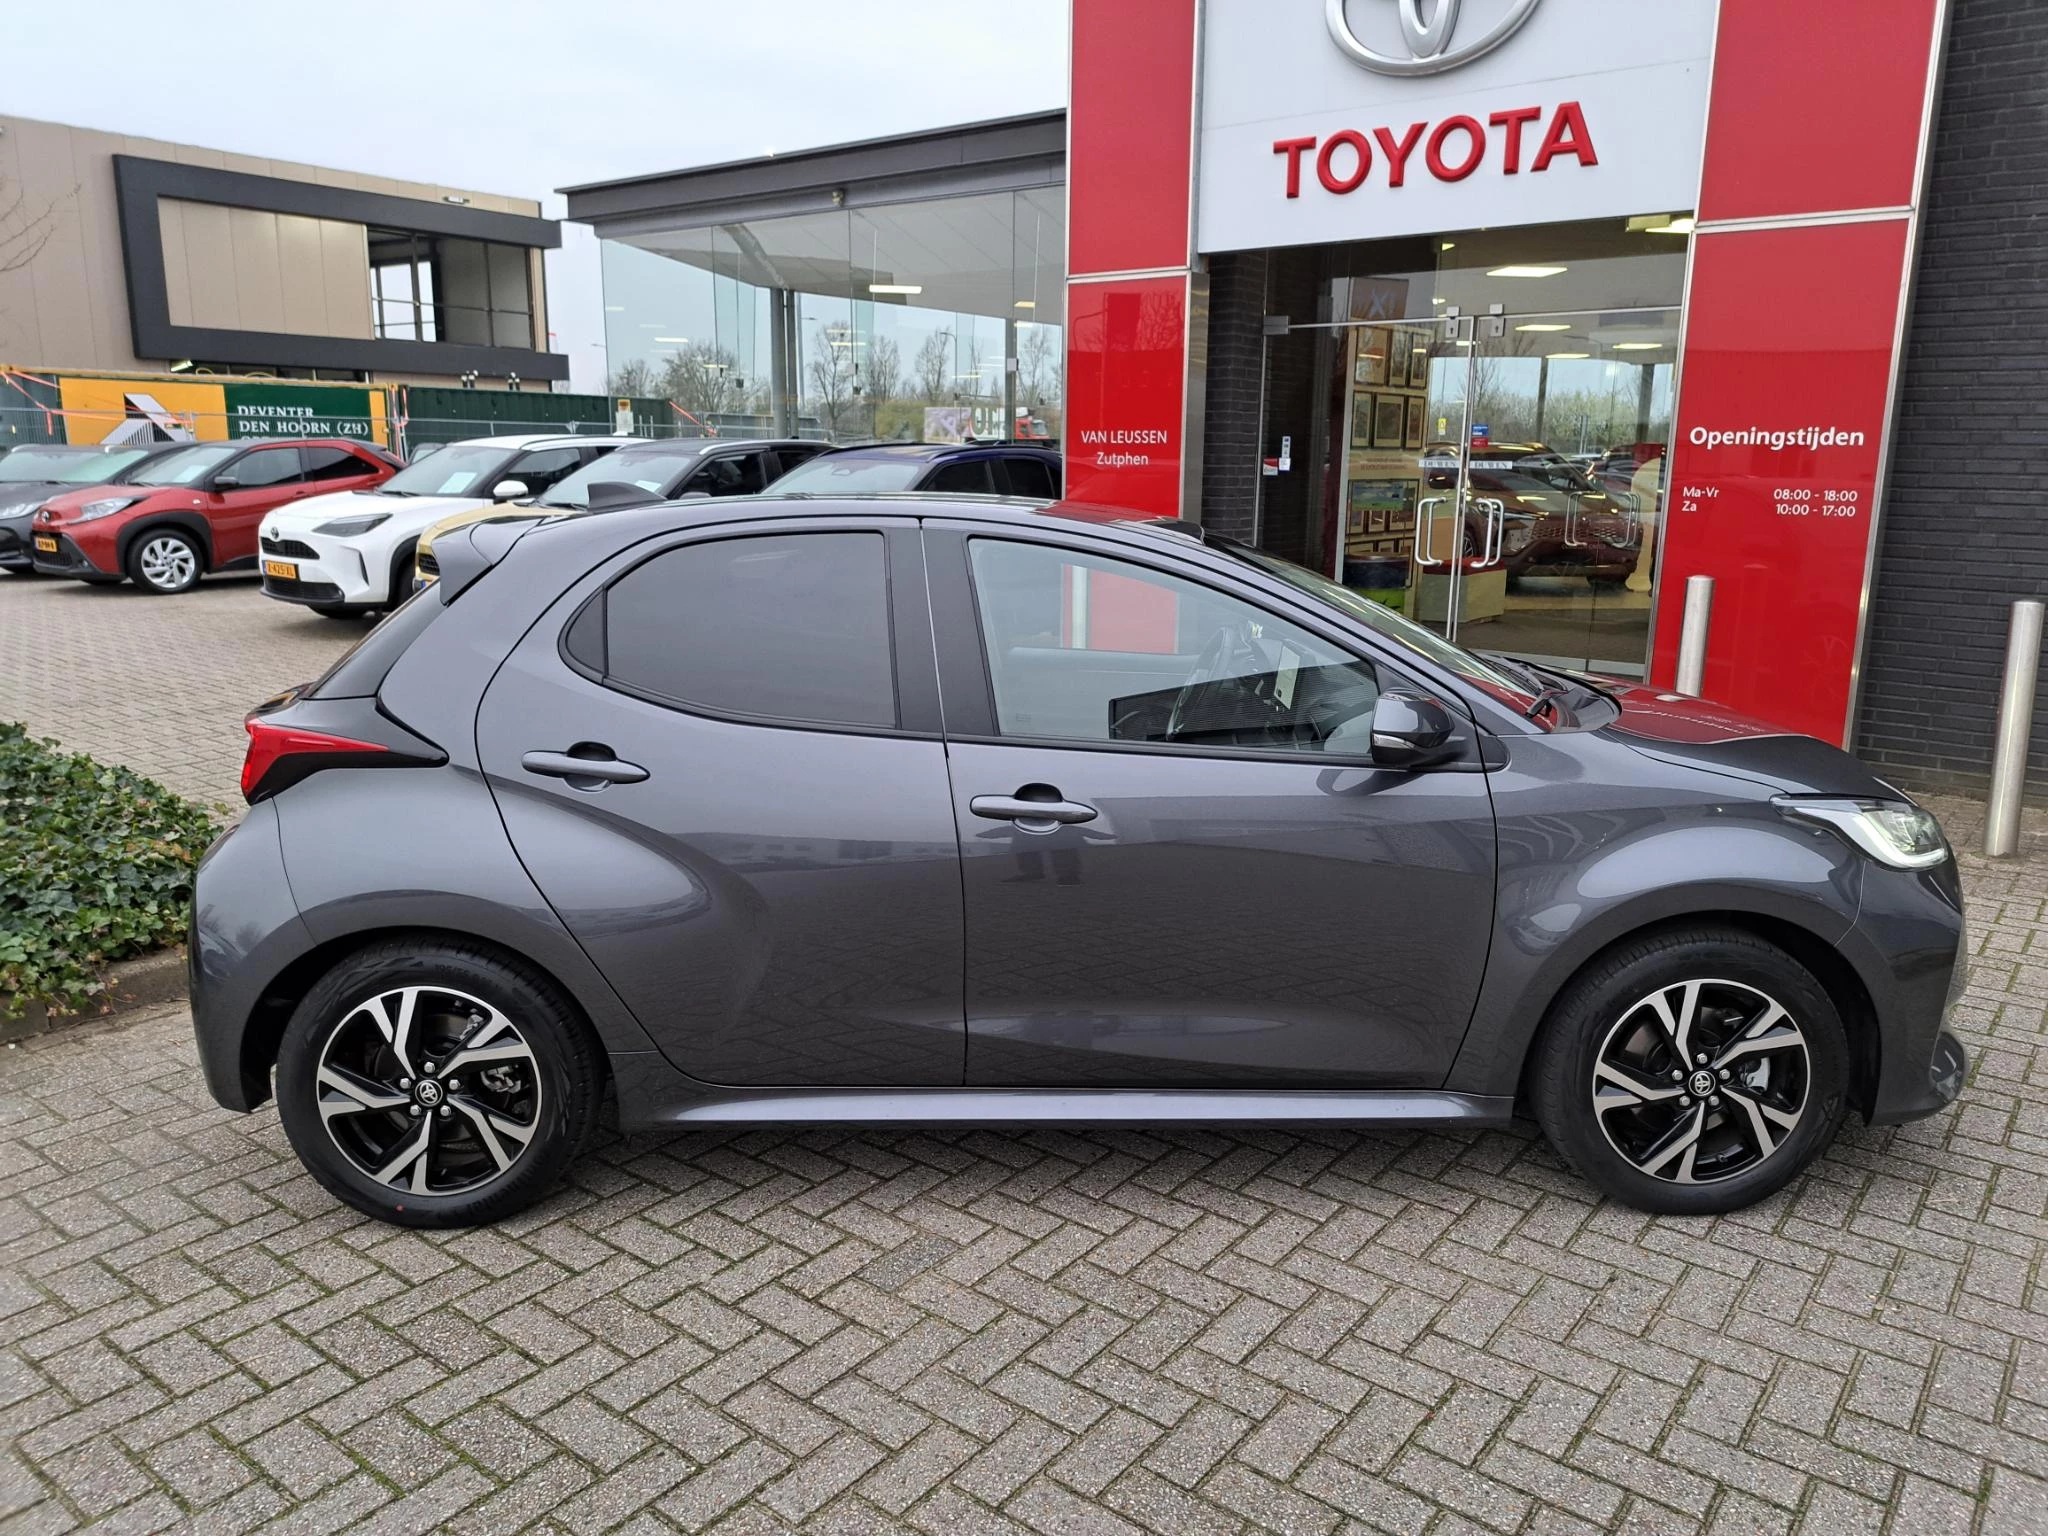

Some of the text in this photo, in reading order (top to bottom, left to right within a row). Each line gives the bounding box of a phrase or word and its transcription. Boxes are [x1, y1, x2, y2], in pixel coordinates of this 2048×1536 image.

[1273, 101, 1598, 198] TOYOTA
[237, 405, 314, 417] DEVENTER
[239, 421, 369, 436] DEN HOORN (ZH)
[1080, 430, 1168, 444] VAN LEUSSEN
[1689, 426, 1865, 451] Openingstijden
[1096, 451, 1149, 468] Zutphen
[1682, 486, 1720, 498] Ma-Vr
[1773, 488, 1811, 501] 08:00
[1823, 489, 1858, 502] 18:00
[1681, 501, 1697, 512] Za
[1775, 503, 1810, 516] 10:00
[1822, 505, 1856, 517] 17:00
